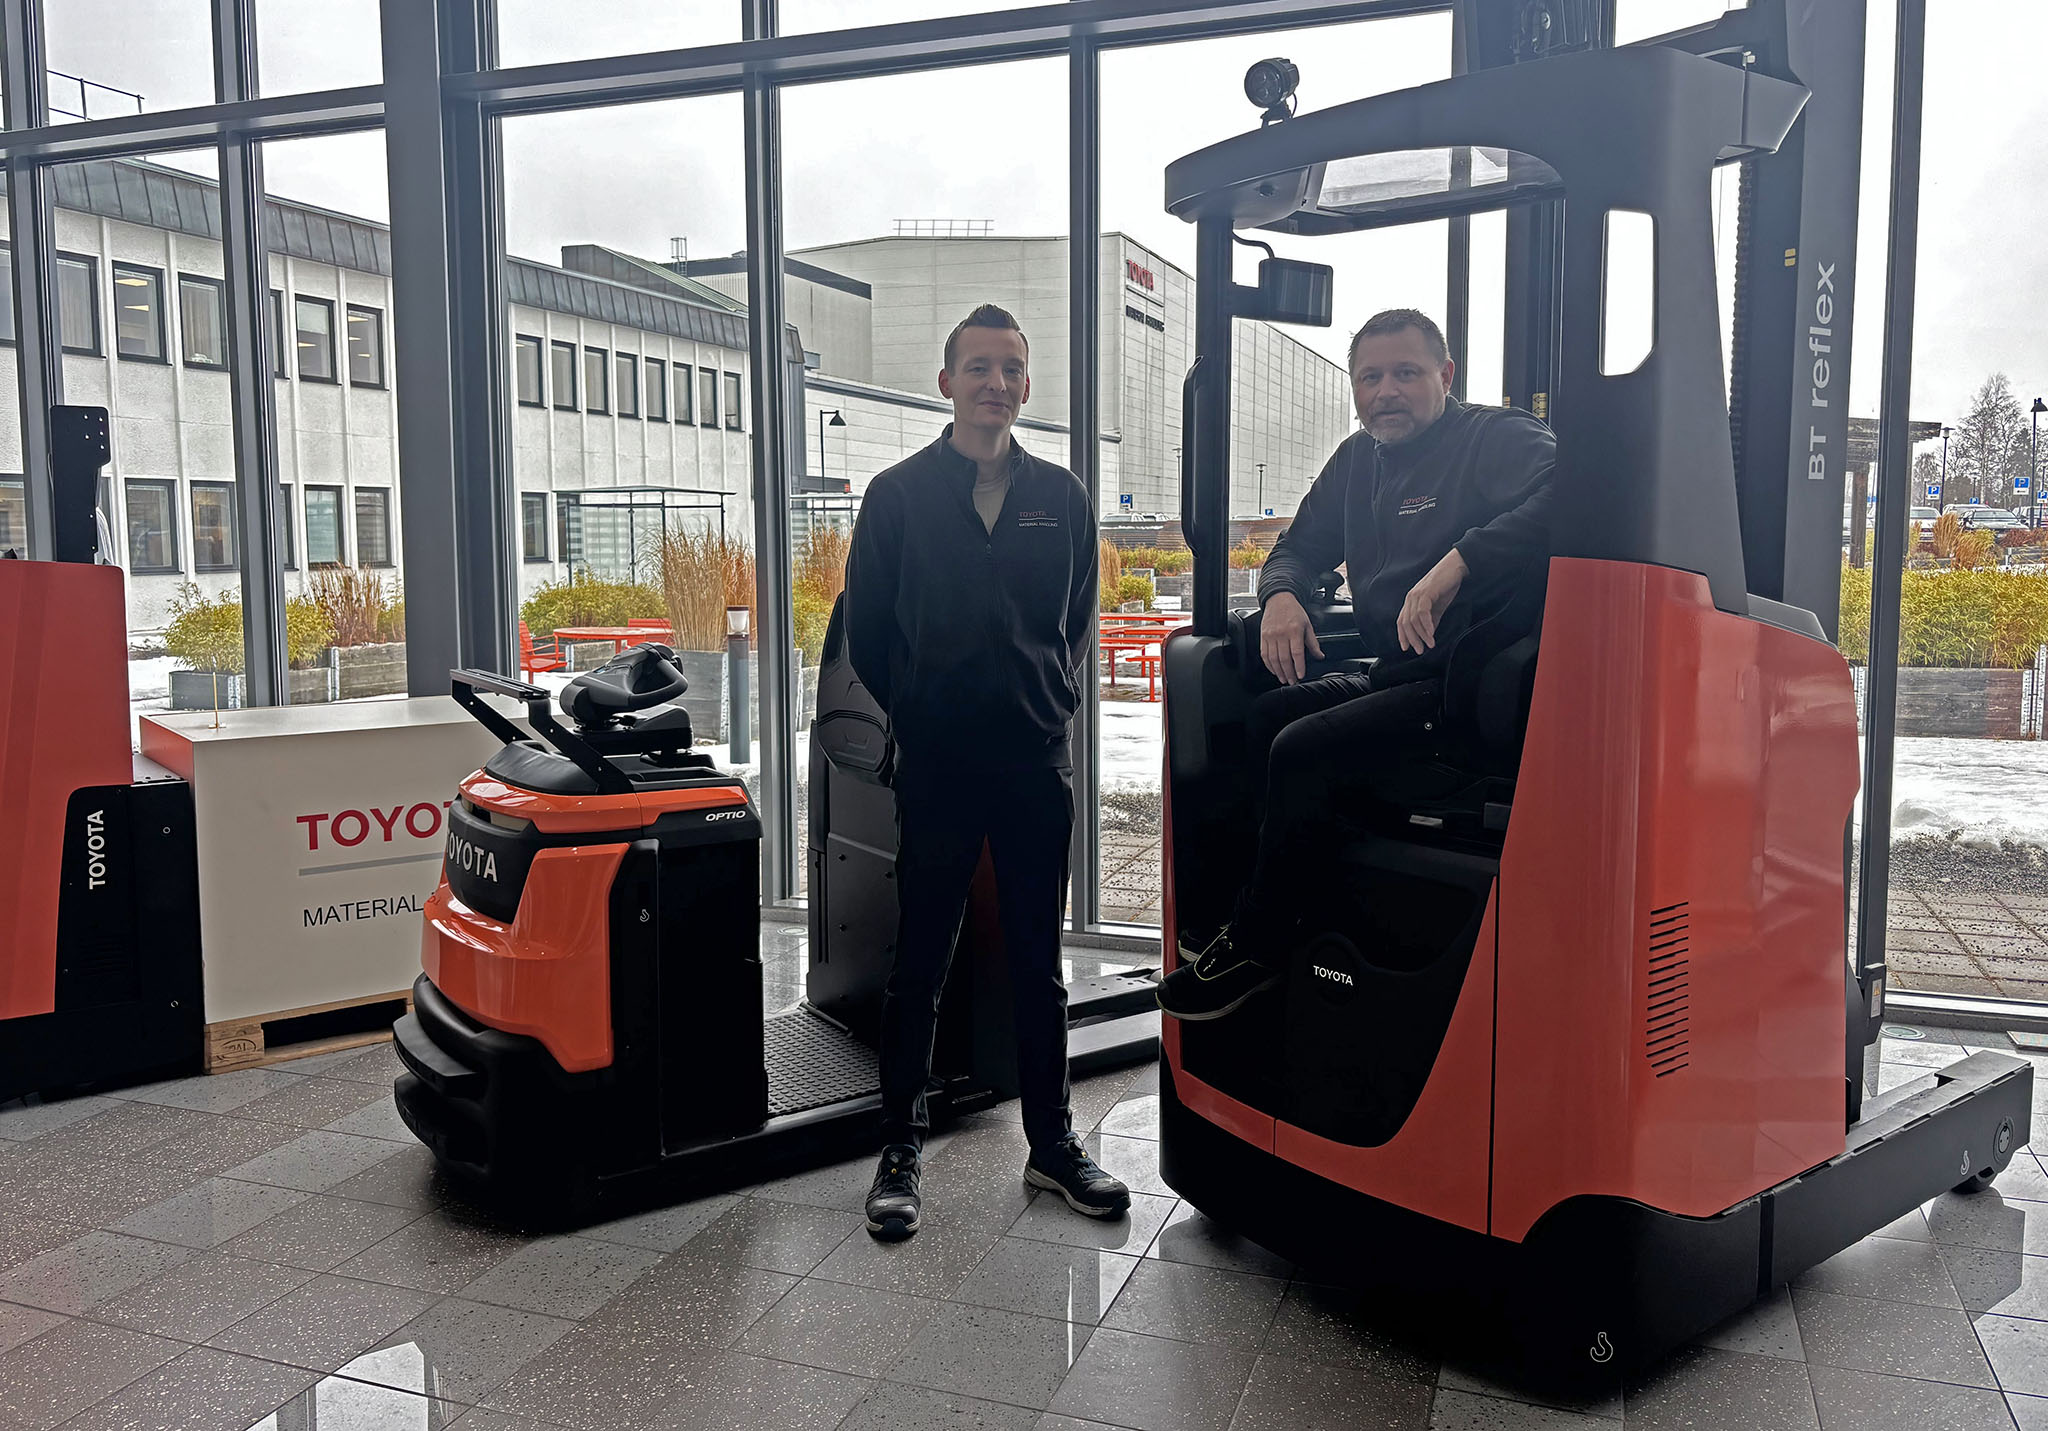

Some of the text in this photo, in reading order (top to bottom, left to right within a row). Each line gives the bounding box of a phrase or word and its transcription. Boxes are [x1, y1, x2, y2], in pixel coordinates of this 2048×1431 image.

[1126, 259, 1154, 291] TOYOTA
[1808, 261, 1835, 480] BT reflex
[296, 801, 453, 850] TOYO
[705, 810, 746, 821] OPTIO
[87, 810, 106, 890] TOYOTA
[303, 894, 424, 927] MATERIAL
[1313, 965, 1354, 986] TOYOTA
